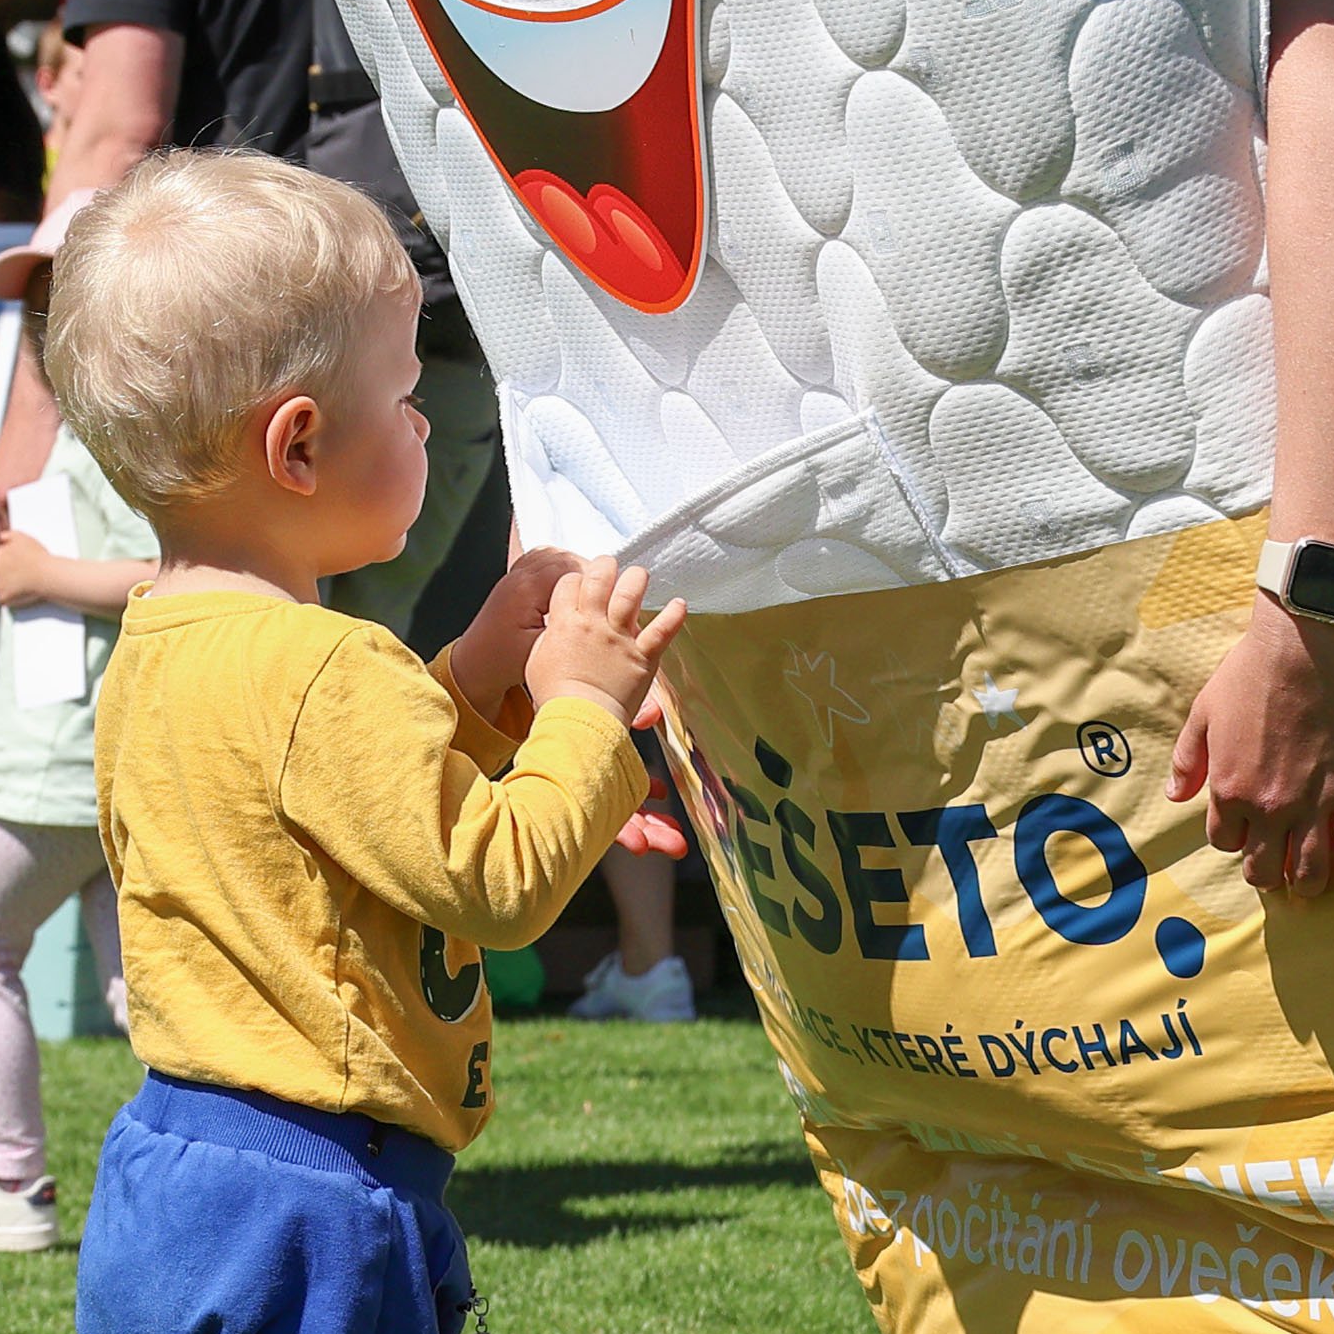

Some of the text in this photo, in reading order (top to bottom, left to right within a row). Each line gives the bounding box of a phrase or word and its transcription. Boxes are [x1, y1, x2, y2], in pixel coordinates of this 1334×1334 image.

[851, 1022, 979, 1079] KTERÉ
[984, 997, 1205, 1078] DÝCHAJÍ
[911, 1180, 1101, 1284] počítání
